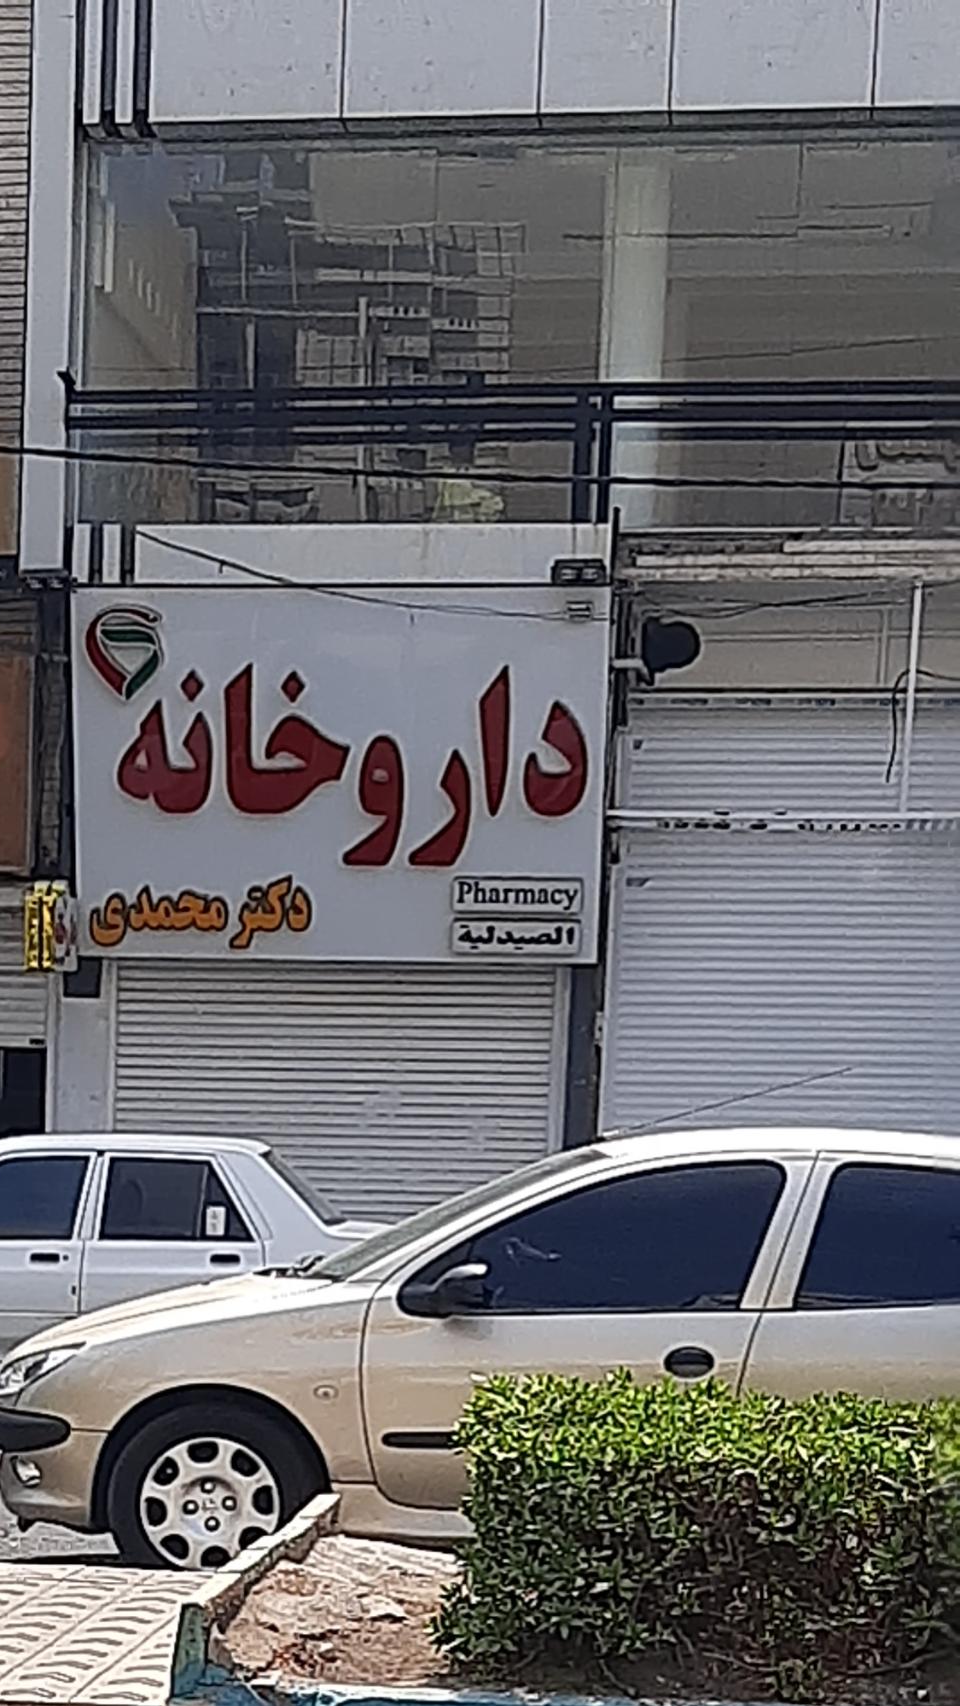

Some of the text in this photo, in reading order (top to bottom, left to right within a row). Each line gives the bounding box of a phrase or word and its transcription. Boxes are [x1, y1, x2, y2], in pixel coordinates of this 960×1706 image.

[116, 661, 589, 867] داروخانه
[88, 875, 313, 949] دکتر محمدی
[456, 880, 579, 911] Pharmacy
